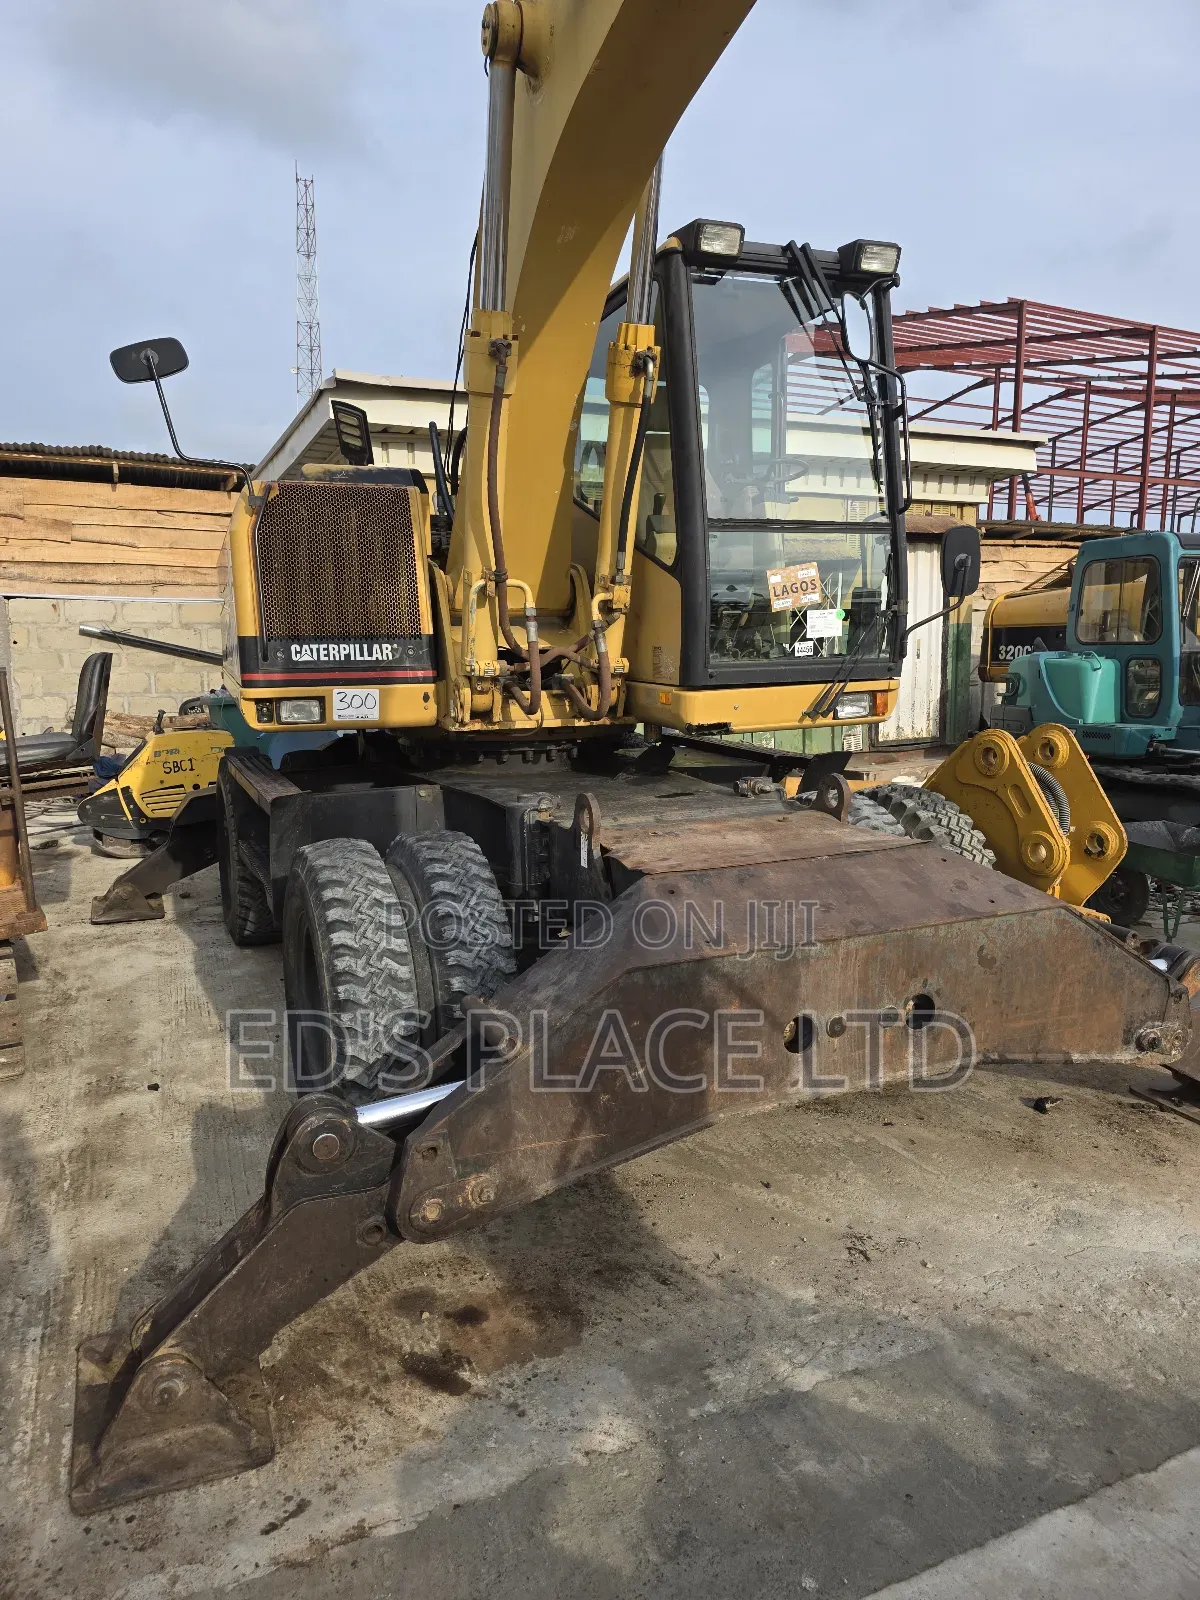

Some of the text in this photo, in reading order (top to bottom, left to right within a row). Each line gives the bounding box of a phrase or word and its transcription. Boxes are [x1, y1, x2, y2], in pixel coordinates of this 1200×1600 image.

[772, 578, 818, 598] LAGOS
[290, 643, 394, 662] CATERPILLAR
[336, 691, 377, 711] 300
[162, 757, 197, 775] SBC1
